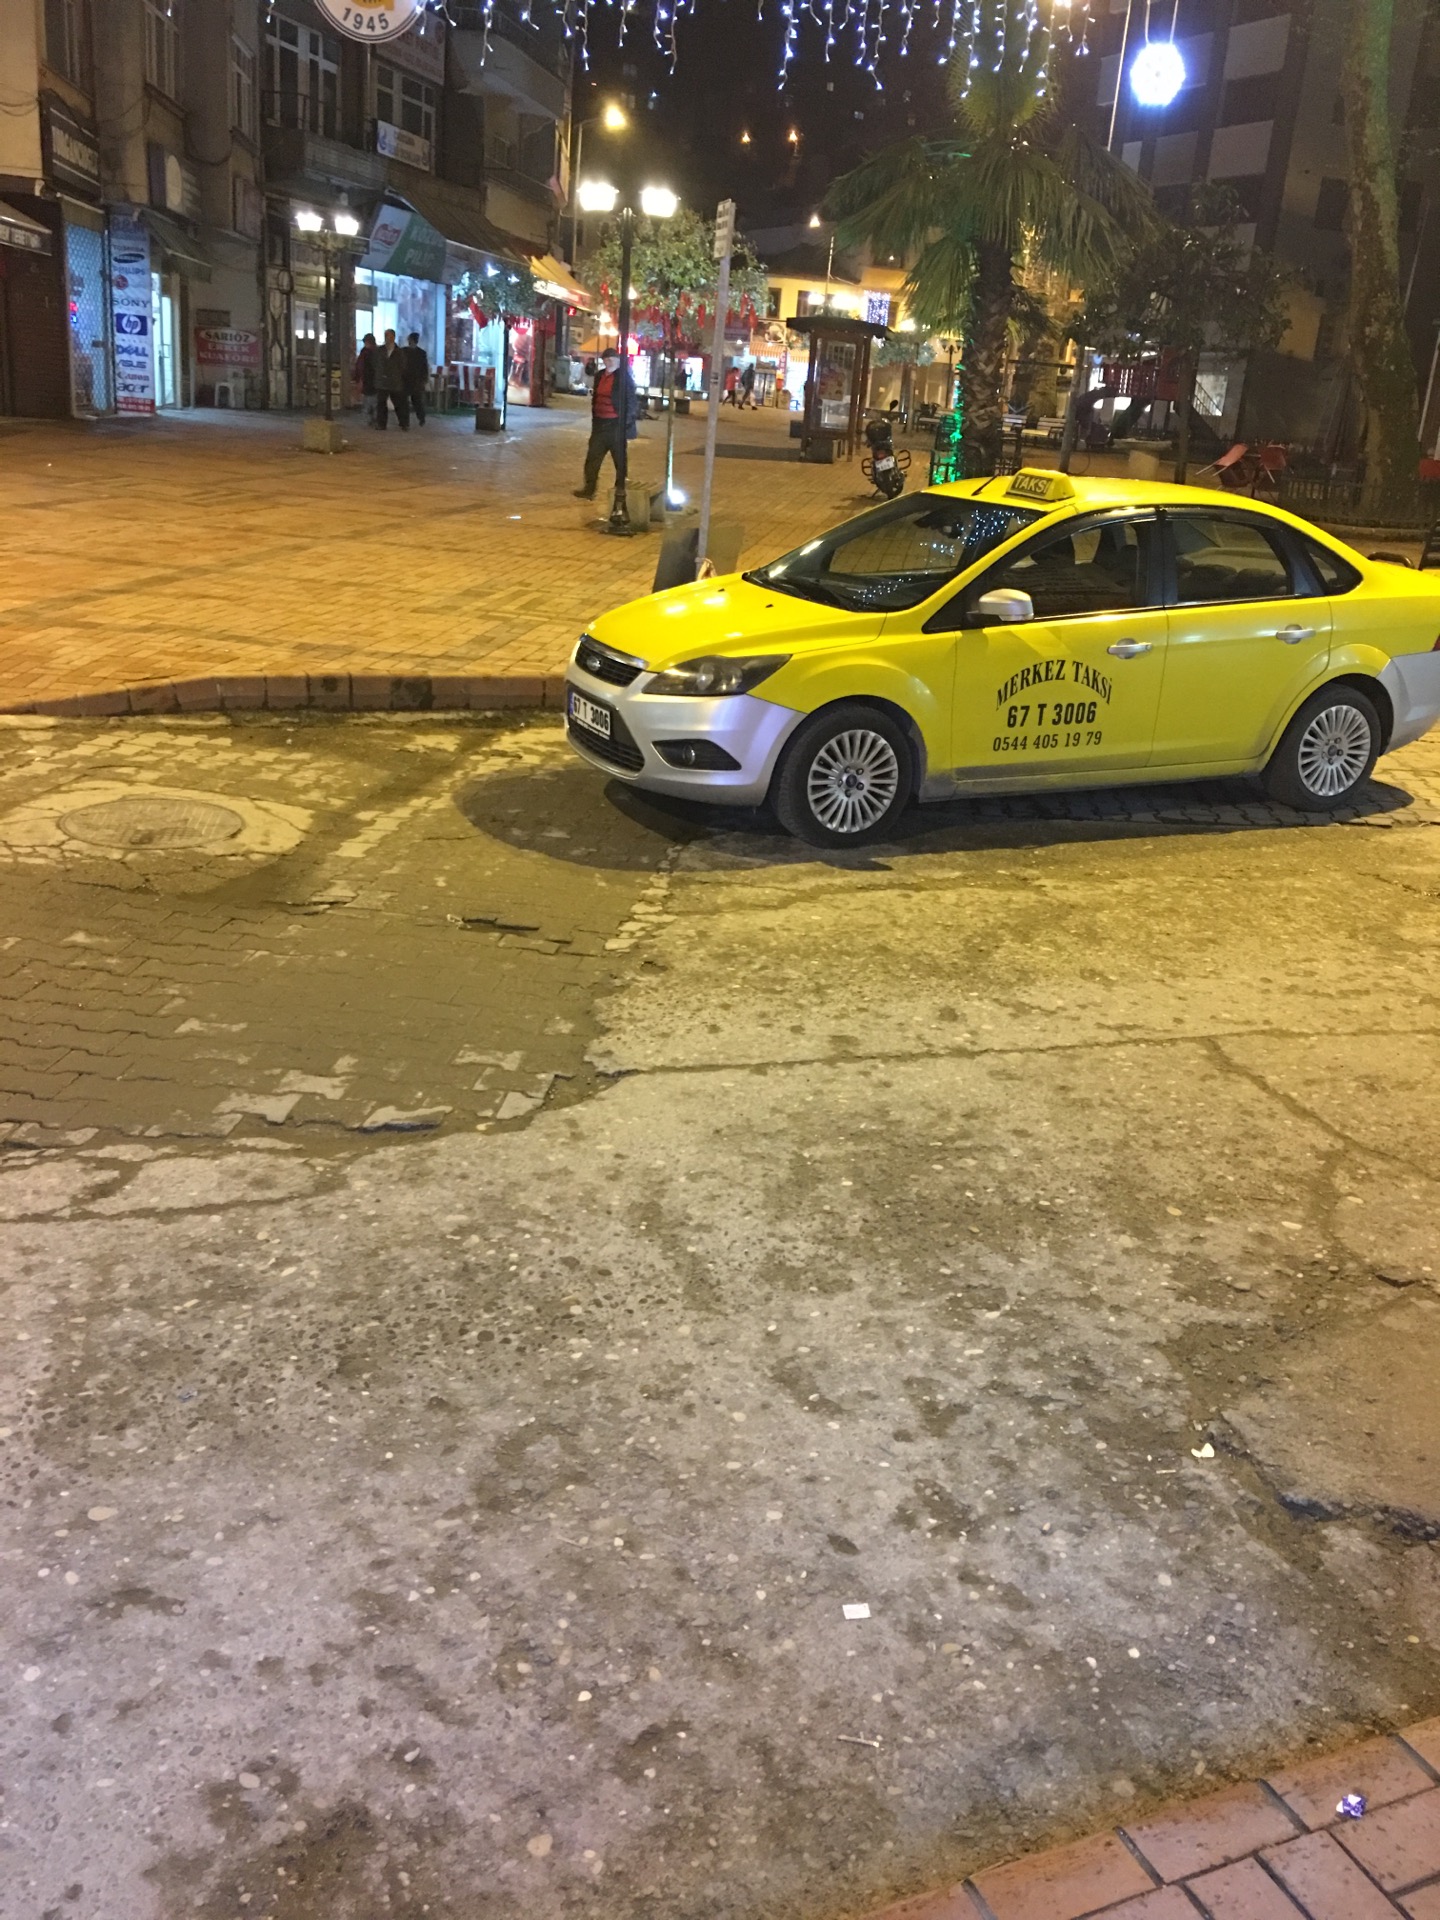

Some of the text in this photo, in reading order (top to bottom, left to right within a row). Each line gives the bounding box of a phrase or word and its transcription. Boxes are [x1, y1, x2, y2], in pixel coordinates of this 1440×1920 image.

[342, 7, 389, 32] 1945
[112, 298, 149, 308] SONY
[117, 383, 149, 394] acer
[996, 660, 1066, 711] MERKEZ
[1007, 701, 1097, 728] 67 T 3006
[992, 730, 1102, 751] 0544 405 19 79
